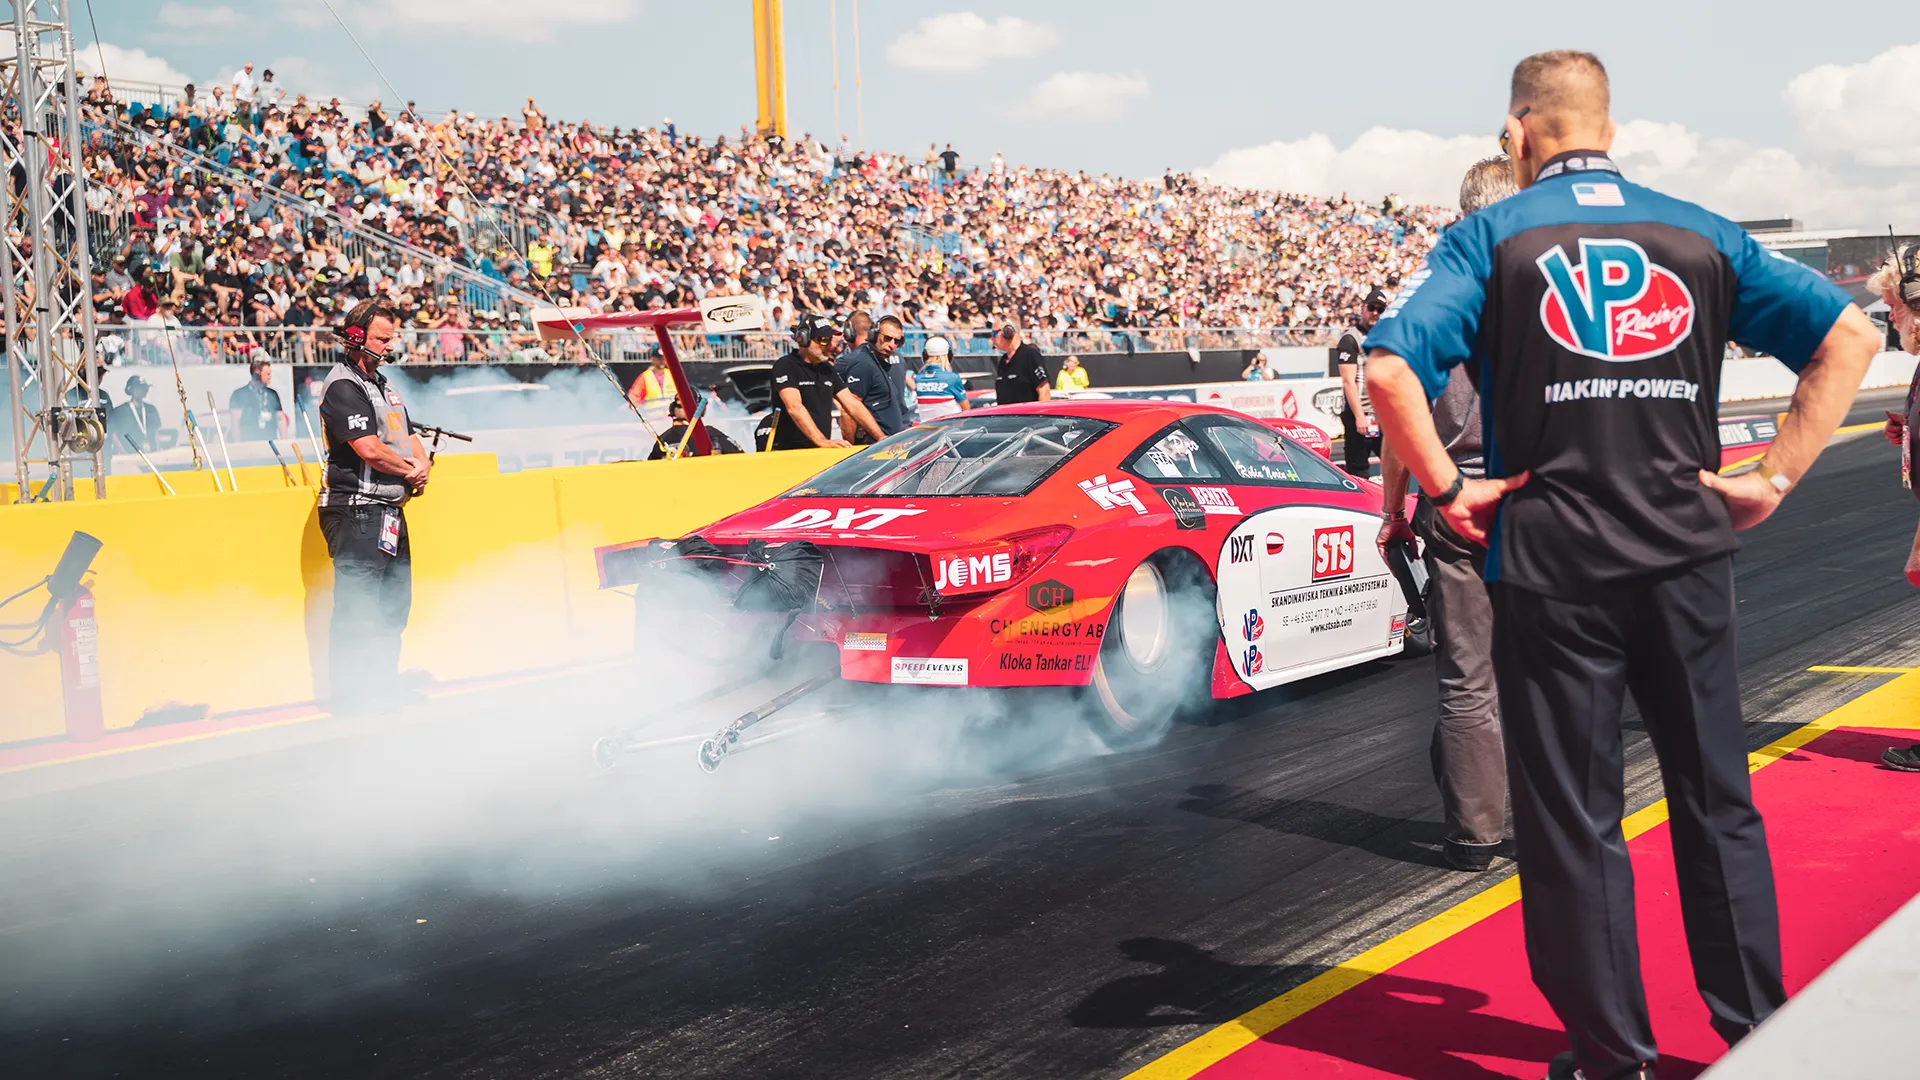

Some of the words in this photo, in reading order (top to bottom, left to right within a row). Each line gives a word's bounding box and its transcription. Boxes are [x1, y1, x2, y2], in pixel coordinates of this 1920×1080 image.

[1536, 238, 1650, 359] VP
[1614, 304, 1692, 346] Racing
[347, 414, 369, 430] KT
[1718, 423, 1753, 445] RING
[1077, 474, 1148, 515] KT
[762, 508, 928, 530] DXT
[1231, 534, 1255, 564] DXT
[1315, 531, 1352, 574] STS
[935, 553, 1011, 590] JOMS
[1036, 586, 1066, 608] CH
[1271, 590, 1319, 608] SKANDINAVISKA
[1319, 586, 1339, 599] TEKNIK
[1381, 579, 1388, 589] AB
[1335, 605, 1343, 616] NO
[990, 620, 1013, 638] CH
[1020, 620, 1082, 638] ENERGY
[1085, 623, 1104, 639] AB
[1244, 608, 1258, 641] VP
[1310, 618, 1352, 634] www.stsab.com
[894, 662, 963, 672] SPEEDEVENTS
[1000, 653, 1032, 670] Kloka
[1035, 653, 1073, 671] Tankar
[1074, 654, 1092, 671] EL!
[1244, 644, 1257, 677] VP
